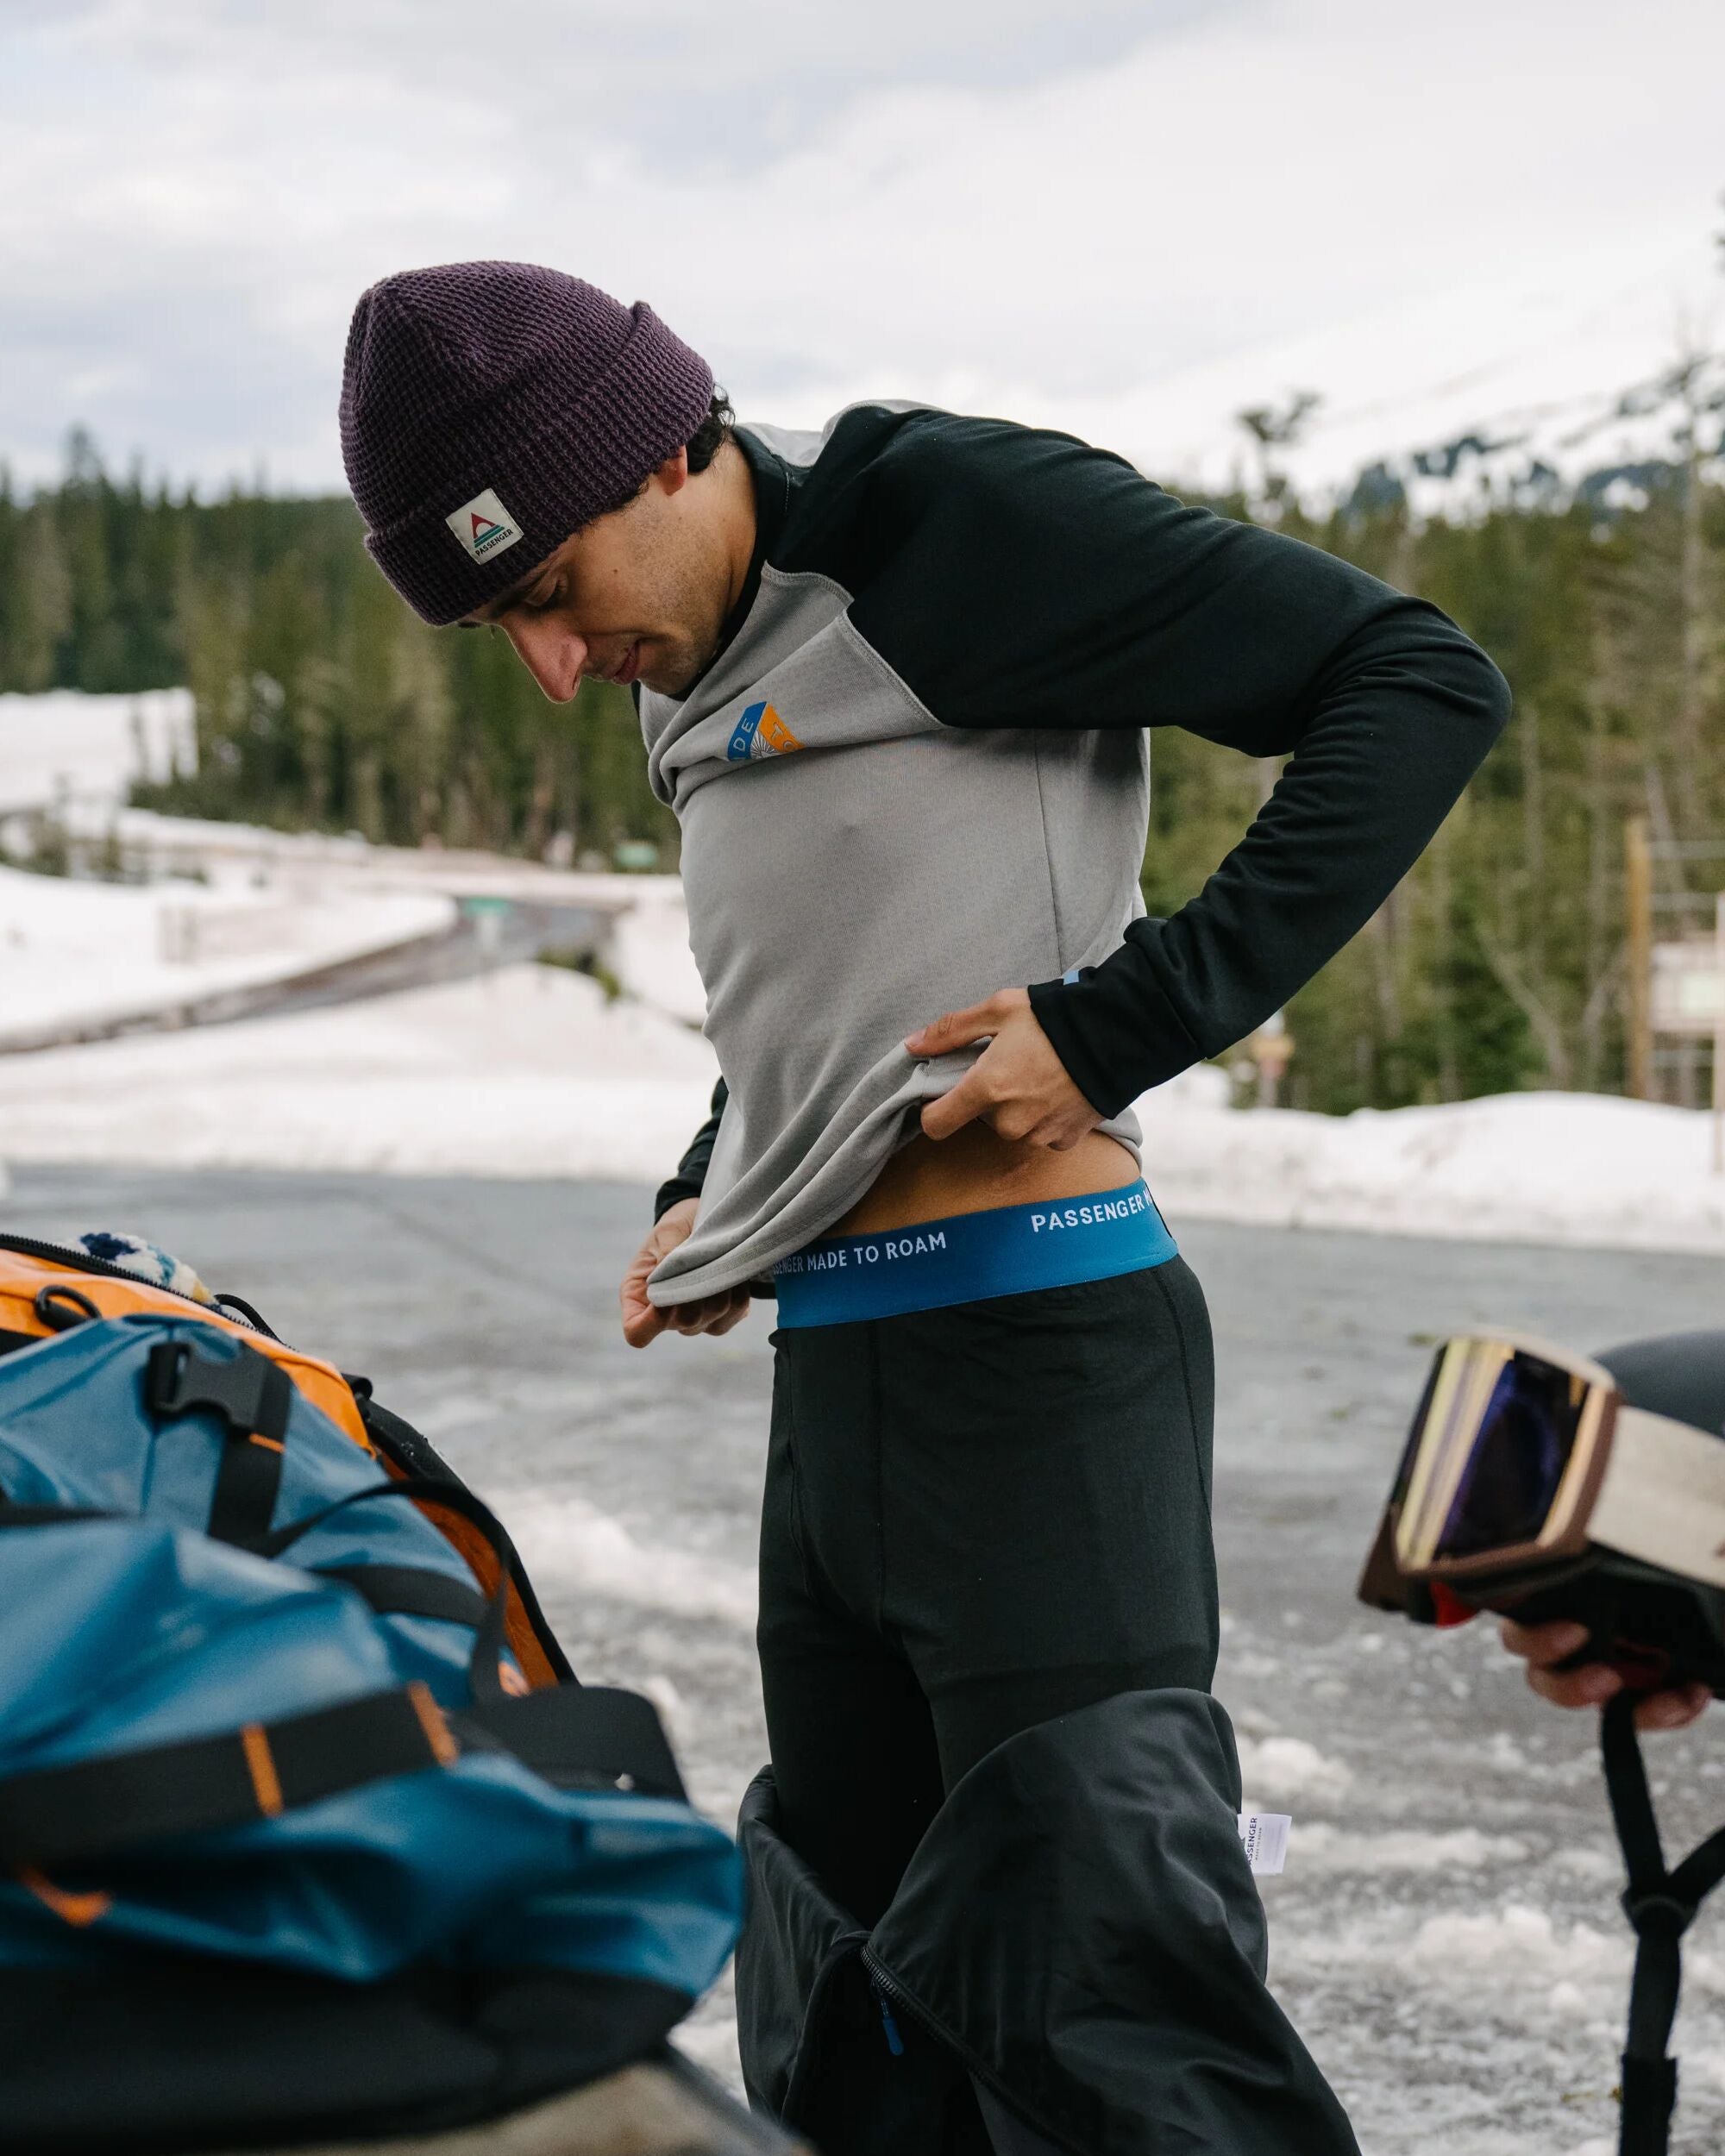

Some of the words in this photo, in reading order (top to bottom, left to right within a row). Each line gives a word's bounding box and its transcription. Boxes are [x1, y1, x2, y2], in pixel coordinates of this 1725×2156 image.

[475, 529, 513, 556] PASSENGER
[1031, 1194, 1145, 1233] PASSENGER
[807, 1250, 847, 1270] MADE
[854, 1246, 879, 1264] TO
[886, 1232, 946, 1260] ROAM
